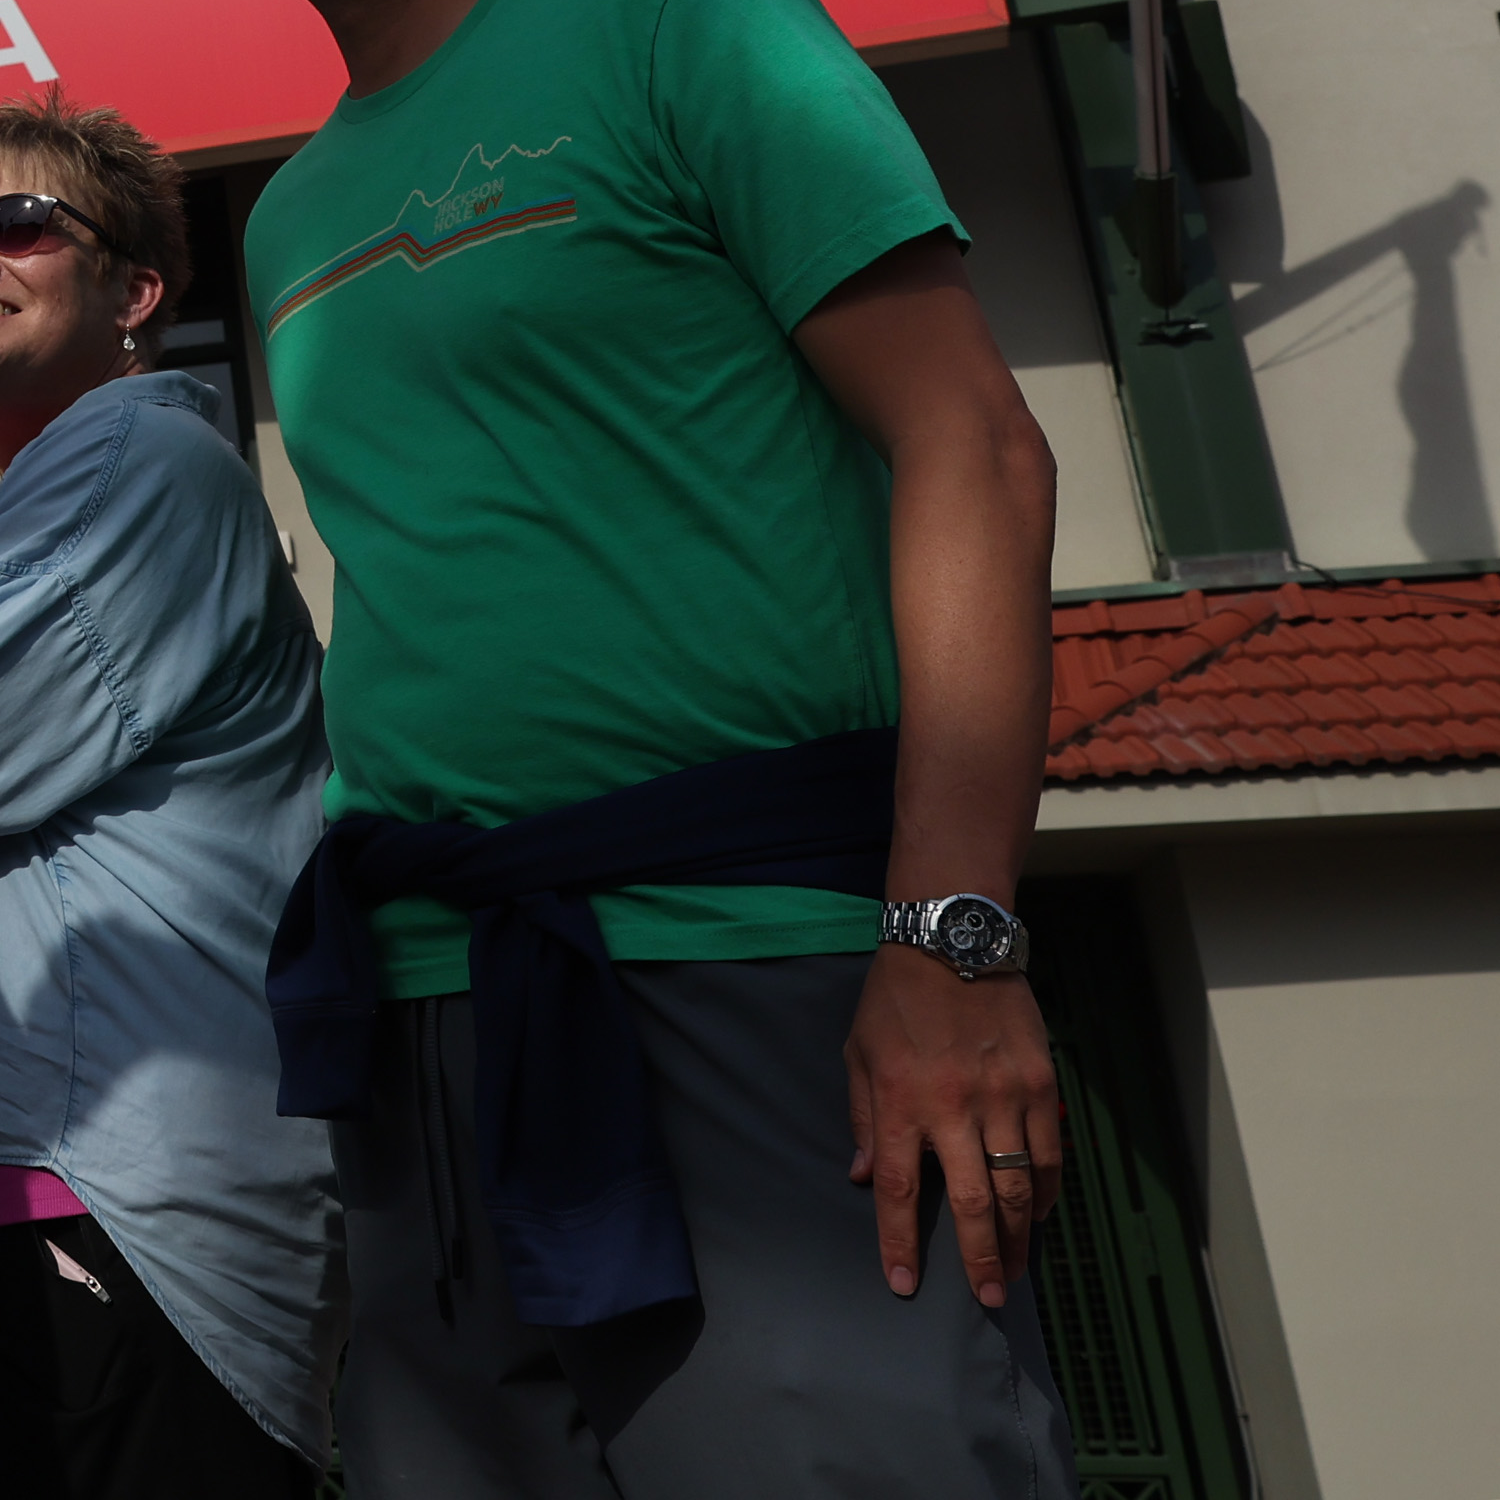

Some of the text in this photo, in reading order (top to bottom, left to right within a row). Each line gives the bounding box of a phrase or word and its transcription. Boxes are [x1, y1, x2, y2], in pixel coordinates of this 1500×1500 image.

[433, 192, 504, 235] HOLE WY
[438, 177, 504, 217] JACKSON
